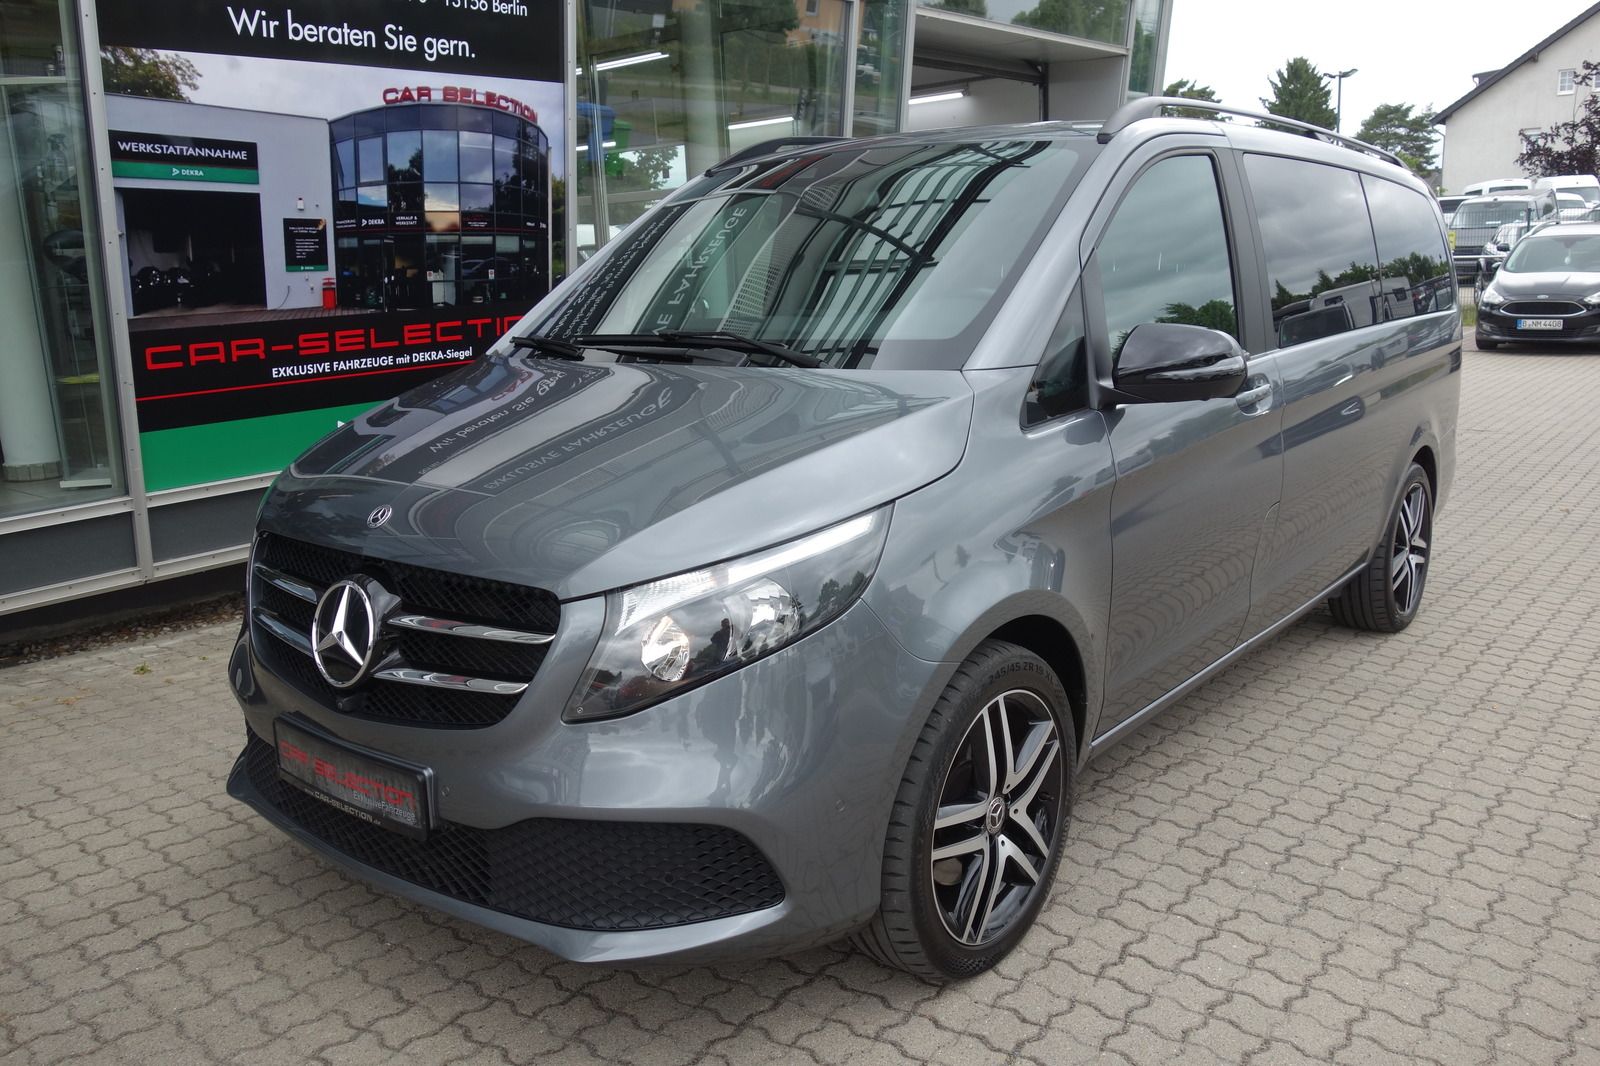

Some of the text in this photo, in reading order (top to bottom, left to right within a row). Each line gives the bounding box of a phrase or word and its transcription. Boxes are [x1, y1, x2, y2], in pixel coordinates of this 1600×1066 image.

[492, 0, 528, 17] Berlin
[227, 6, 475, 62] Wir beraten Sie gern.
[382, 86, 538, 124] CAR SELECTION
[117, 141, 247, 160] WERKSTATTANNAHME
[181, 168, 204, 177] DEKRA
[272, 346, 473, 378] EXKLUSIVE FAHRZEUGE mit DEKRA-Siegel
